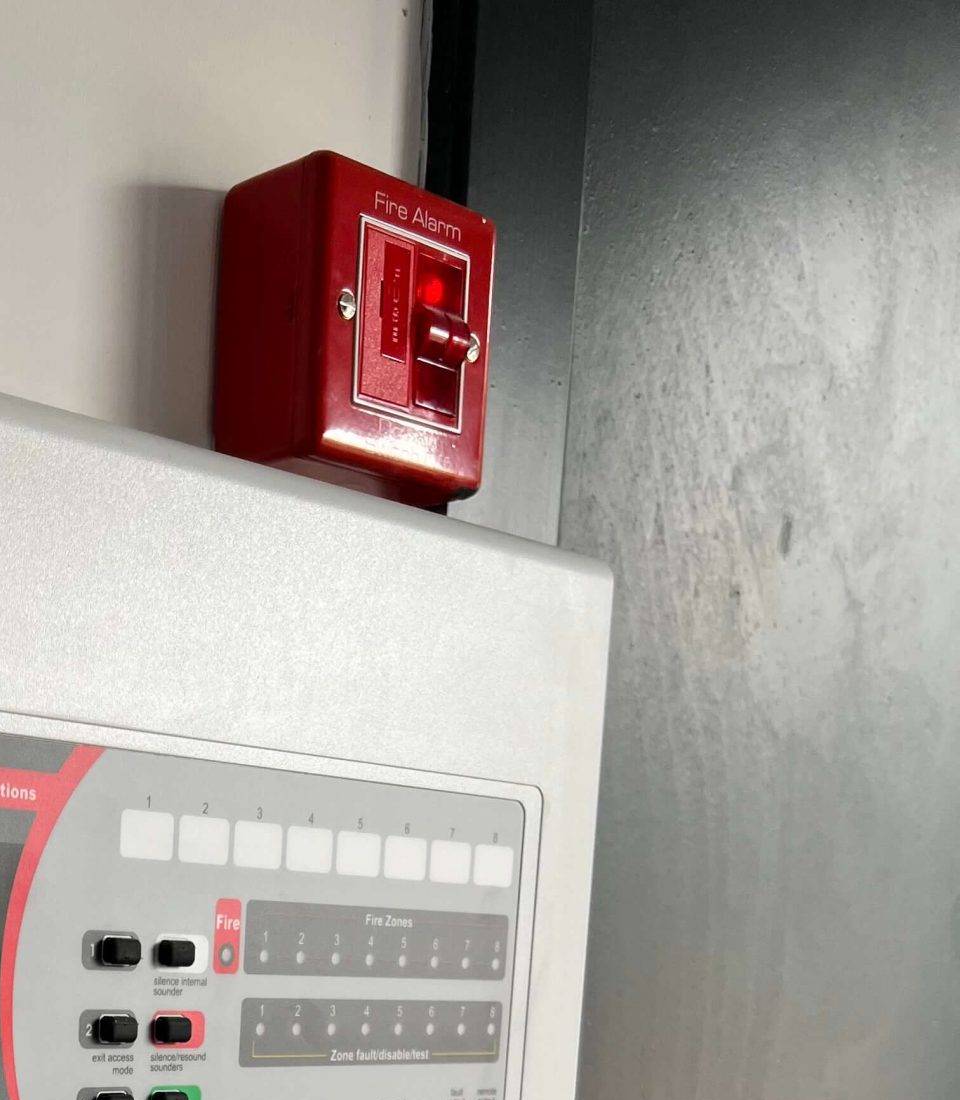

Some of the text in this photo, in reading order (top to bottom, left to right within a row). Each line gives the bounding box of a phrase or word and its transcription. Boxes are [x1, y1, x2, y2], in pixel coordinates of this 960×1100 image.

[374, 190, 461, 242] Fire Alarm
[146, 795, 498, 843] 1 2 3 4 5 6 7 8
[216, 914, 240, 930] Fire
[365, 913, 413, 928] Fire Zones
[264, 930, 500, 953] 1 2 3 4 5 6 7 8
[90, 943, 95, 957] 1
[153, 977, 208, 987] silence internal
[153, 987, 183, 996] sounder
[261, 1004, 496, 1018] 1 2 3 4 5 6 7 8
[86, 1024, 93, 1037] 2
[92, 1053, 134, 1063] exit access
[150, 1053, 206, 1062] silence/resound
[330, 1048, 429, 1061] Zone fault/disable/test
[112, 1065, 134, 1075] mode
[150, 1063, 184, 1072] sounders
